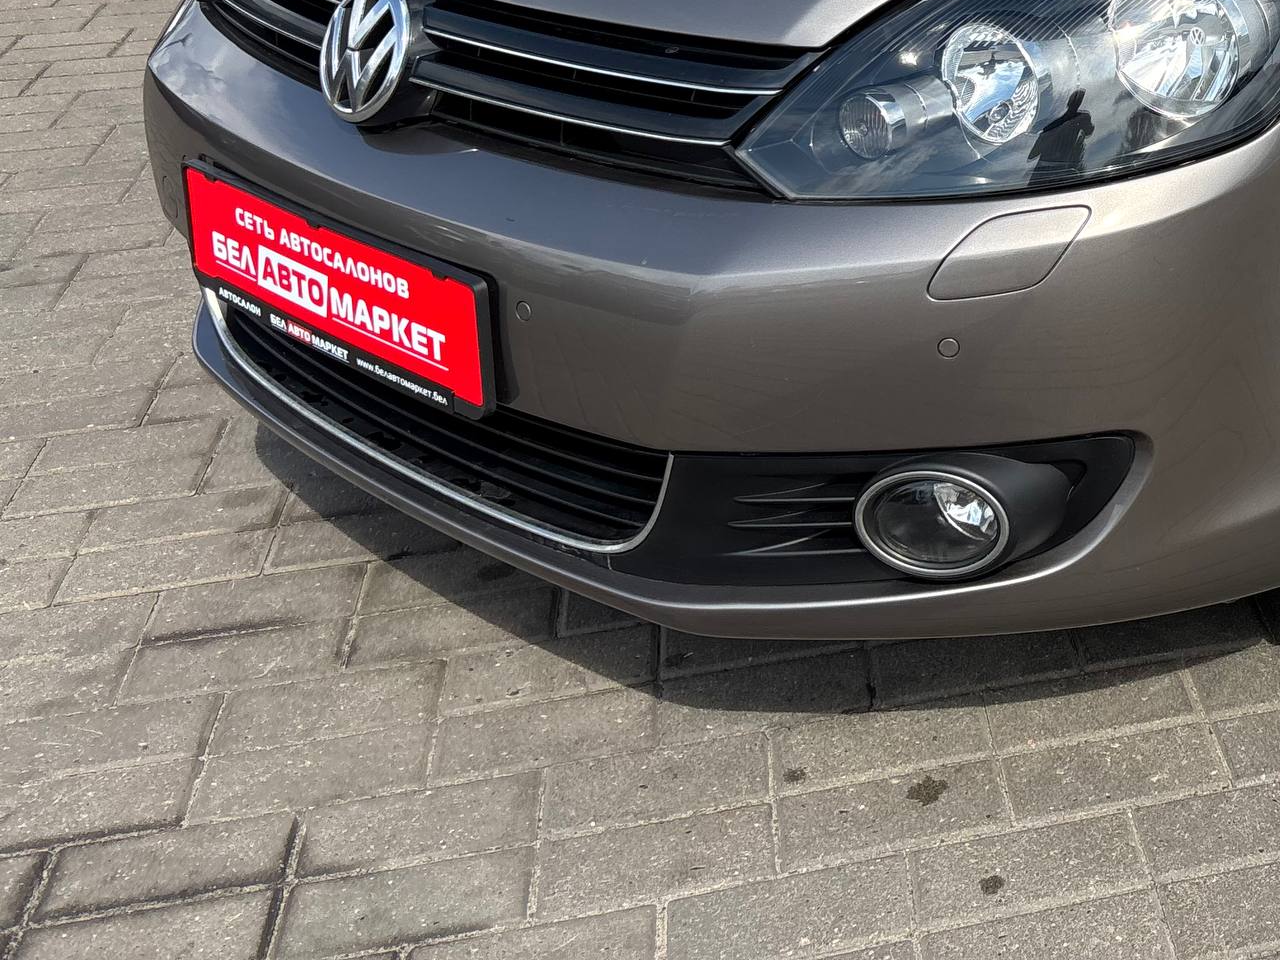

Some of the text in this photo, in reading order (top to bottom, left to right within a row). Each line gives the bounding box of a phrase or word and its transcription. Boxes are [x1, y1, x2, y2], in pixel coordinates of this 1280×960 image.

[234, 207, 410, 299] СЕТЬ АВТОСАЛОНОВ
[219, 287, 262, 317] АВТОСАЛОН
[356, 358, 449, 406] www.белавтомаркет.бел
